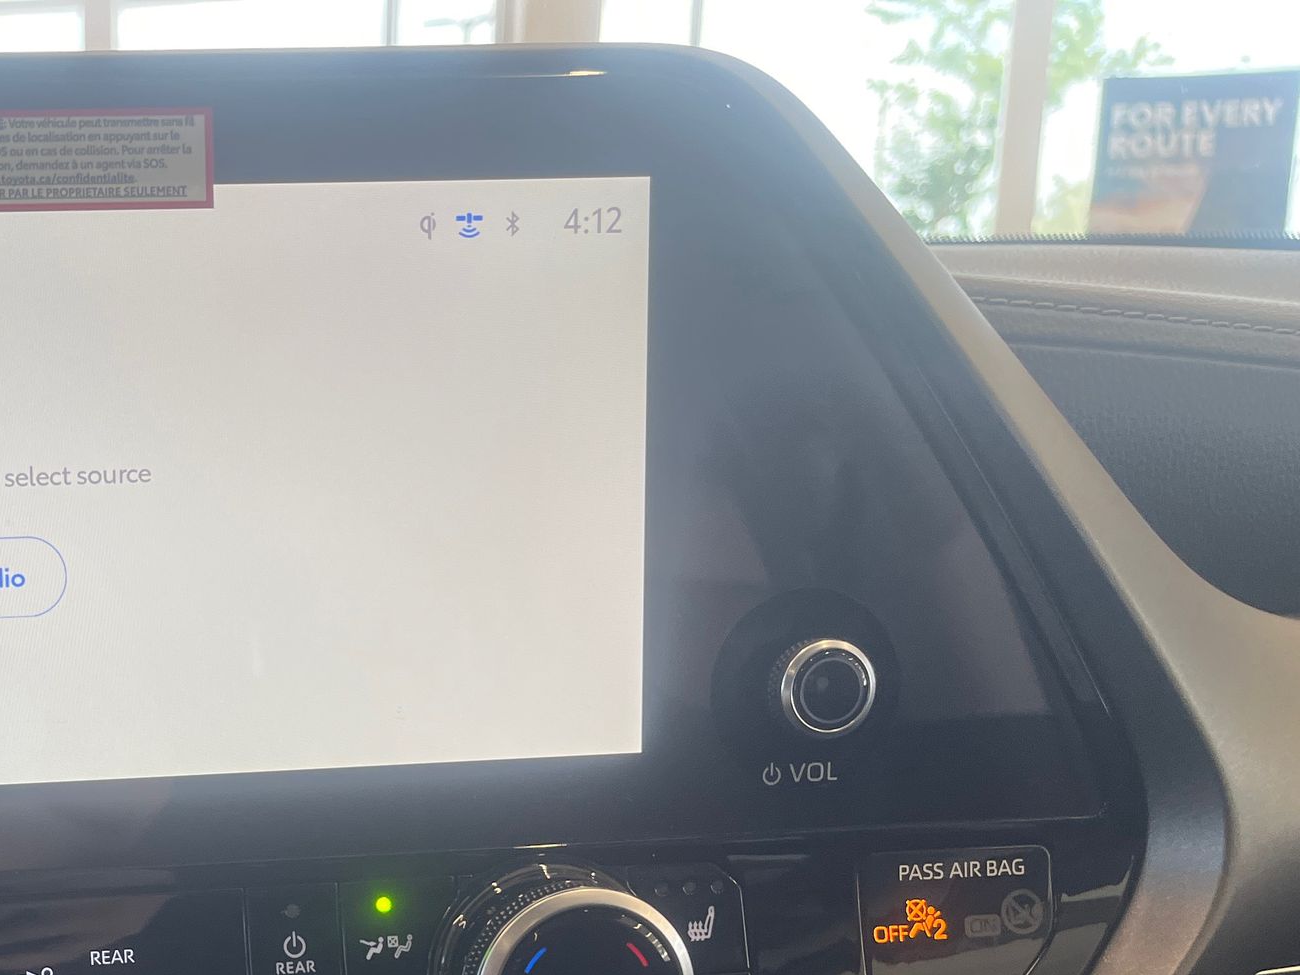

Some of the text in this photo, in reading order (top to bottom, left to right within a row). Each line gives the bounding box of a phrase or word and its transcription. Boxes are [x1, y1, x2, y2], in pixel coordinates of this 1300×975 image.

[1111, 97, 1283, 128] FOR EVERY
[1109, 129, 1216, 160] ROUTE
[564, 206, 623, 235] 4:12
[3, 465, 72, 488] select
[76, 467, 152, 485] source
[789, 761, 838, 783] VOL
[899, 858, 1025, 881] PASS AIR BAG
[873, 924, 909, 943] OFF
[971, 919, 998, 932] ON
[90, 948, 135, 966] REAR
[276, 960, 316, 974] REAR
